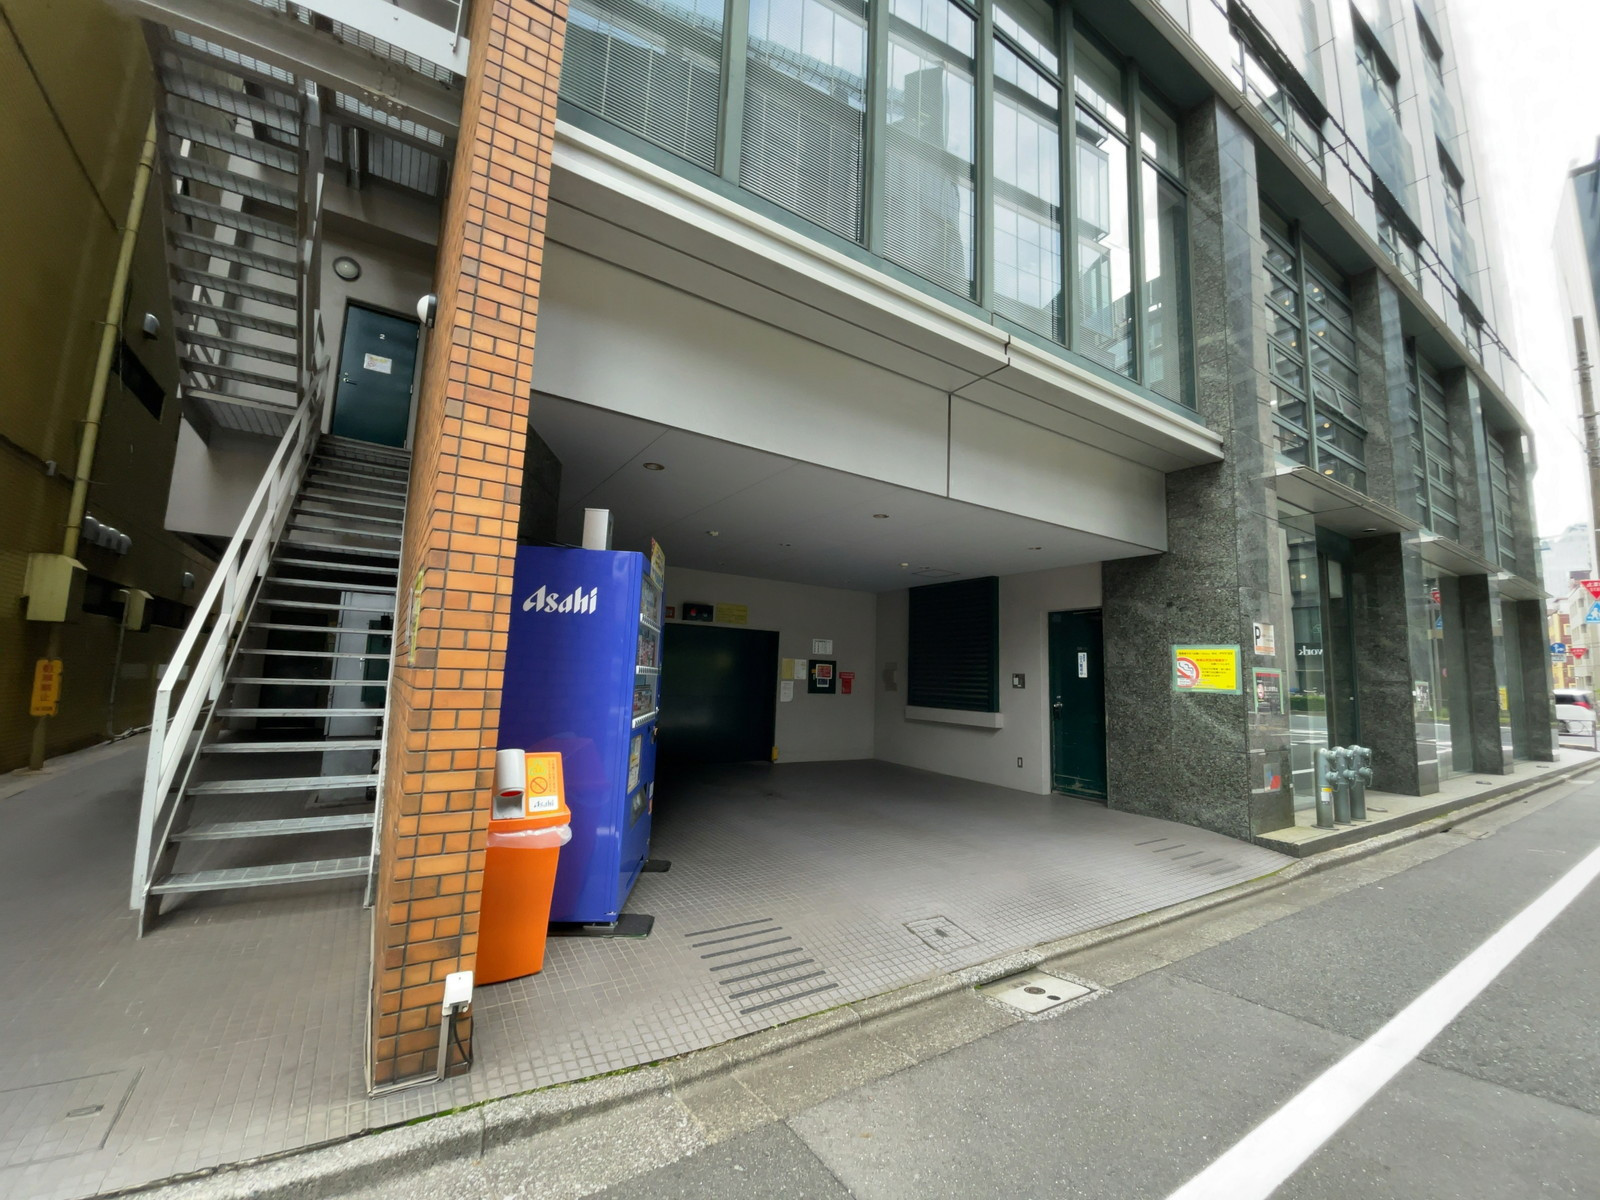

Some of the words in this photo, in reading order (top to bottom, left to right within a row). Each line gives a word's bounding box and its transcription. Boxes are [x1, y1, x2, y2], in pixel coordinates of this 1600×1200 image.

[522, 584, 598, 615] Asahi
[1254, 625, 1261, 646] P
[533, 799, 555, 808] Asahi
